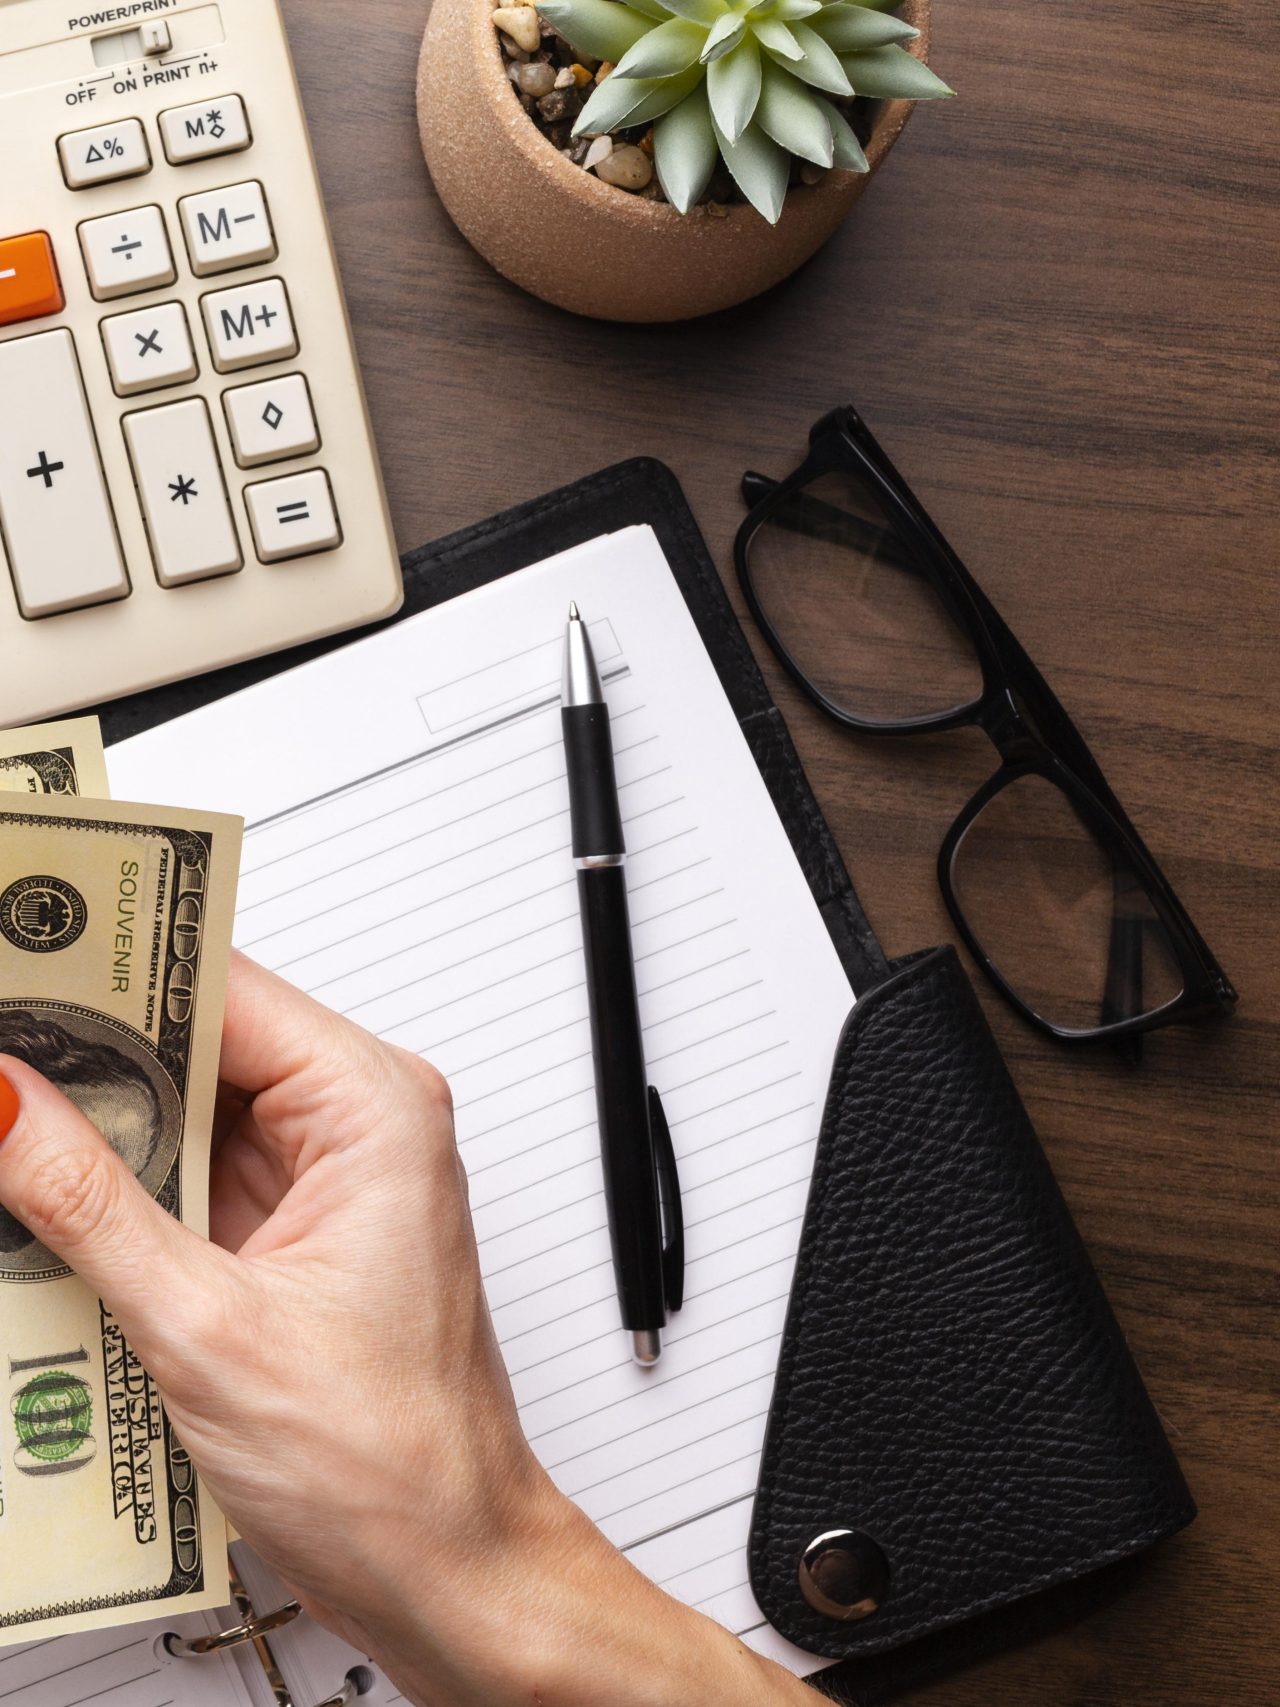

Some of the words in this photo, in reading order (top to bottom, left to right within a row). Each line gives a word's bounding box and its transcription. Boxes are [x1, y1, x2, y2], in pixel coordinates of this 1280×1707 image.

[65, 88, 97, 106] OFF
[113, 78, 138, 95] ON
[143, 65, 192, 88] PRINT
[221, 304, 279, 342] M+
[156, 847, 170, 920] FEDERAL
[111, 860, 139, 993] SOUVENIR
[149, 919, 163, 991] RESERVE
[144, 993, 157, 1032] NOTE
[7, 1343, 98, 1479] 100
